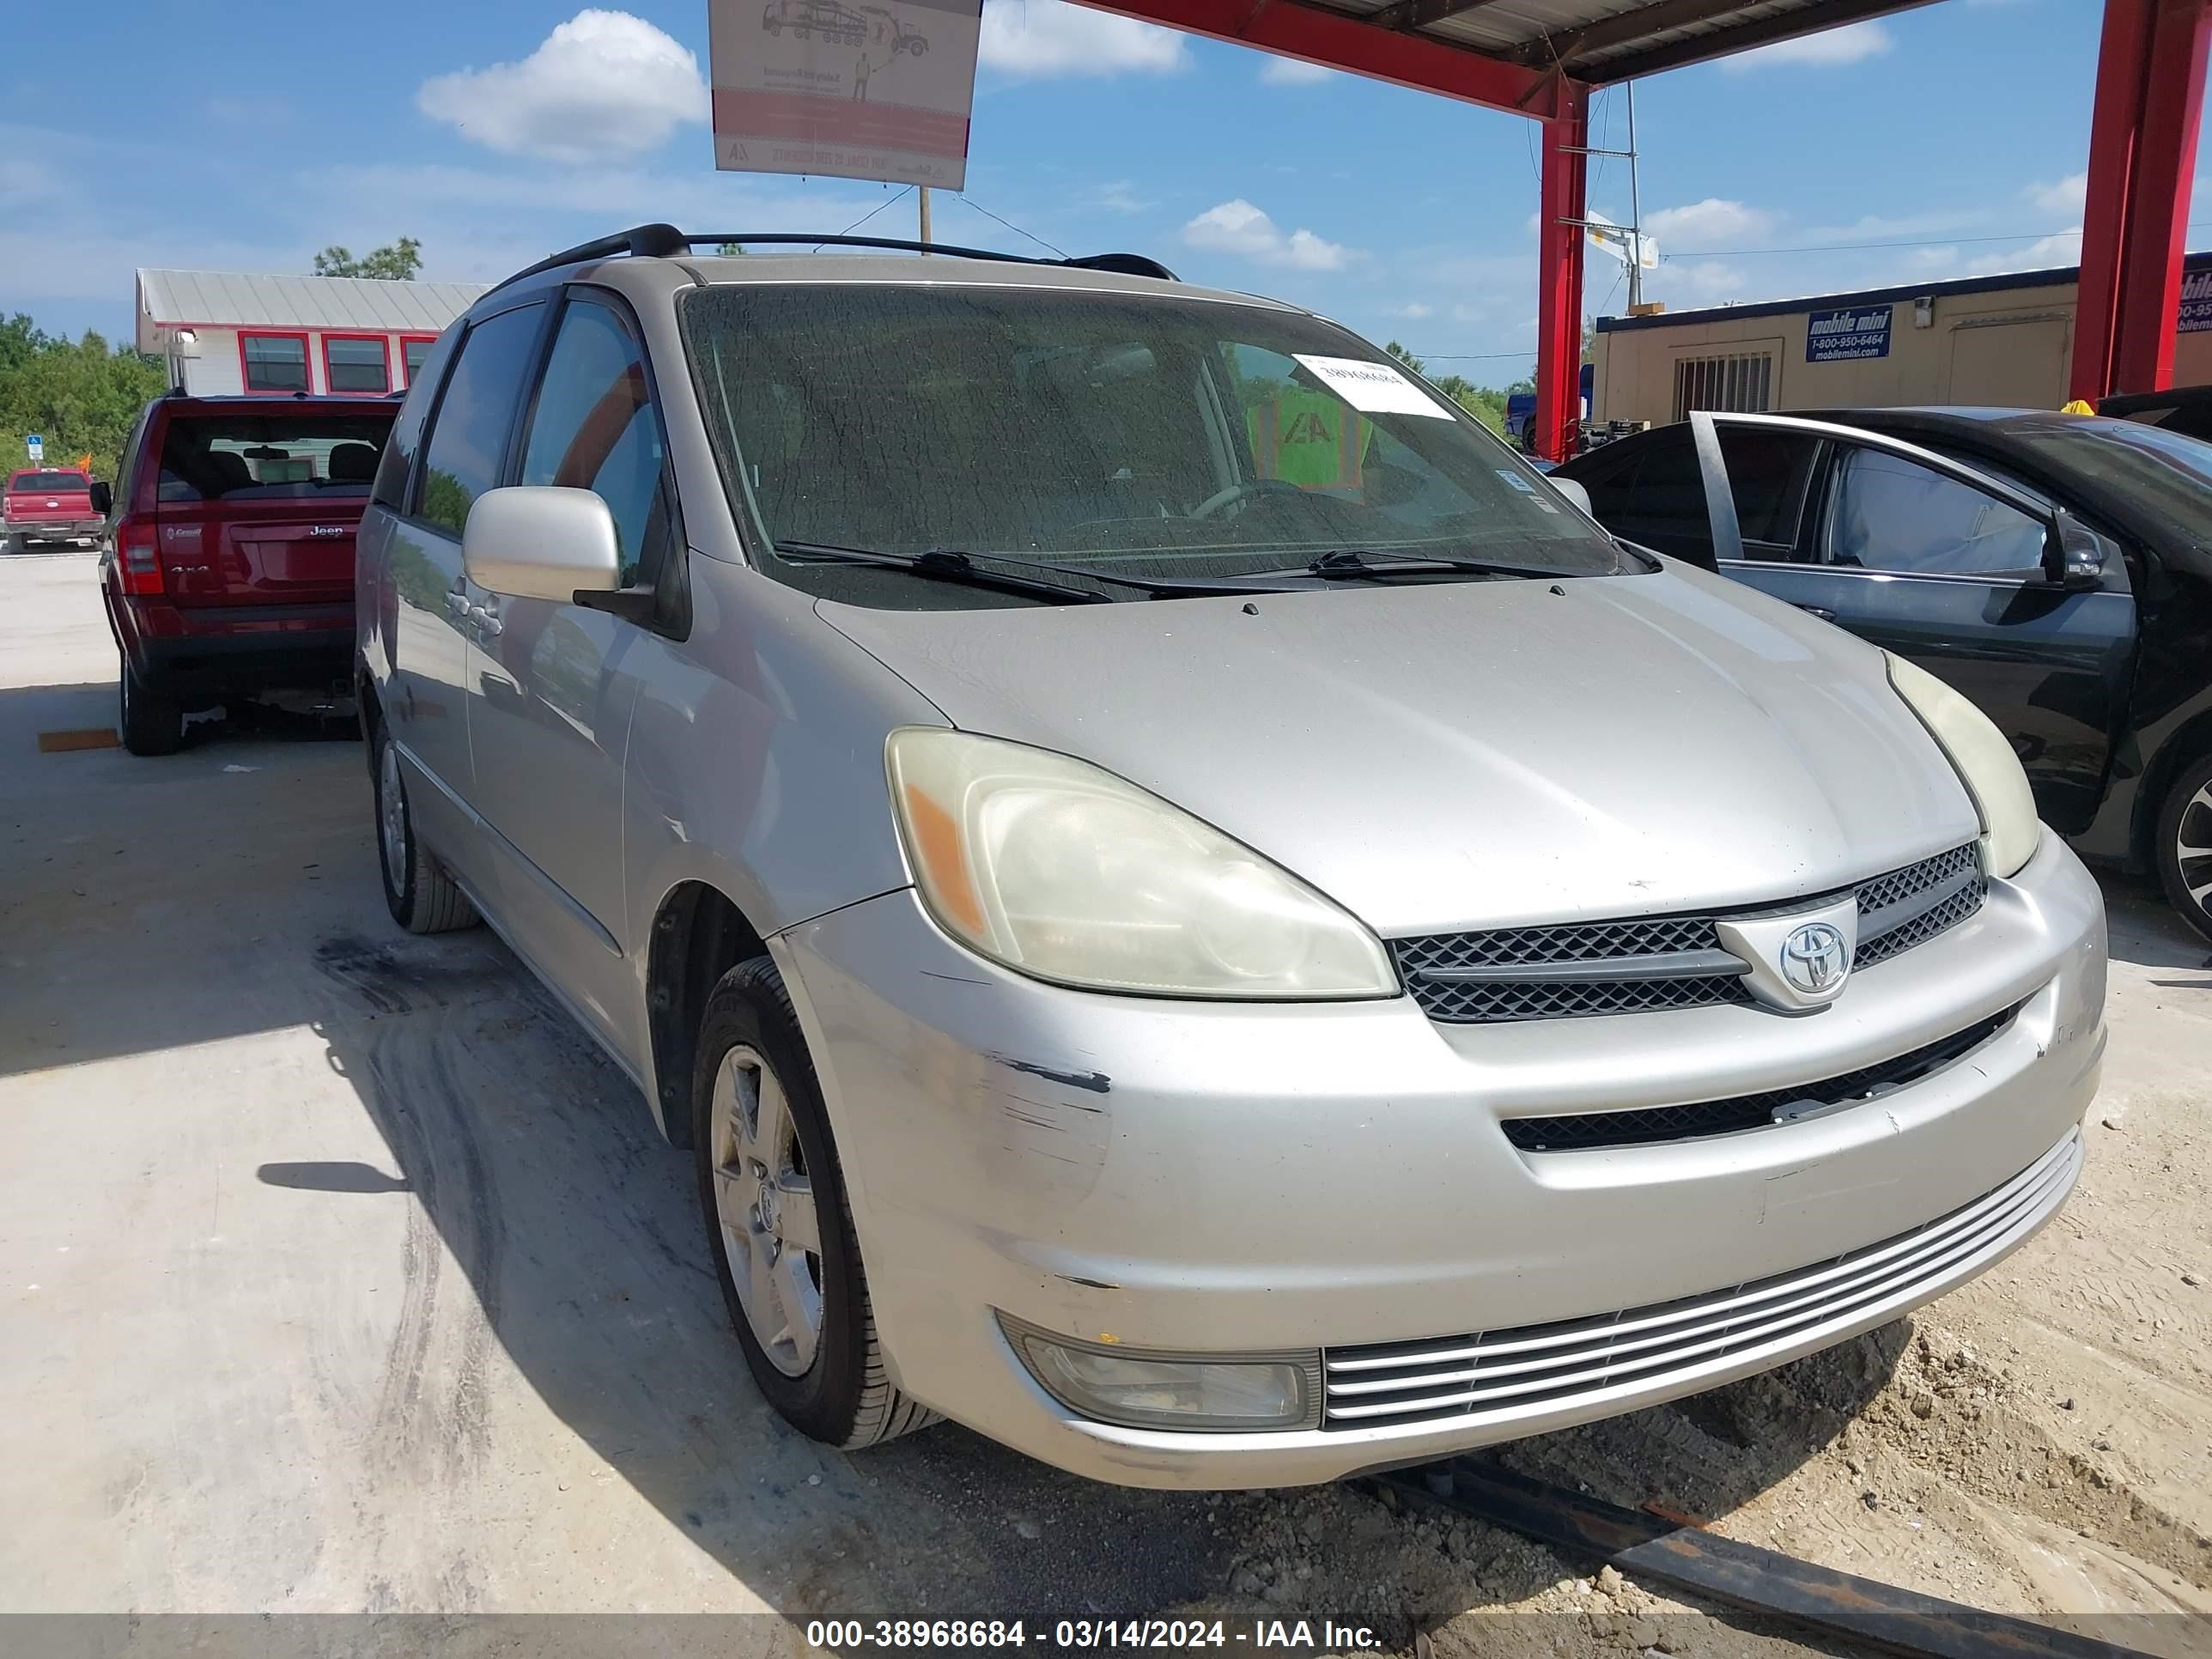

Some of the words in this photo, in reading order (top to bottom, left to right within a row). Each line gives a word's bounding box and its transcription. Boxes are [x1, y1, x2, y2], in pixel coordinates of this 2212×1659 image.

[2181, 273, 2212, 300] bile
[1810, 311, 1856, 335] mobile
[1856, 310, 1889, 331] mini
[1813, 334, 1884, 349] 1-800-950-6464
[1814, 348, 1879, 361] mobilemini.com
[310, 526, 343, 537] Jeep
